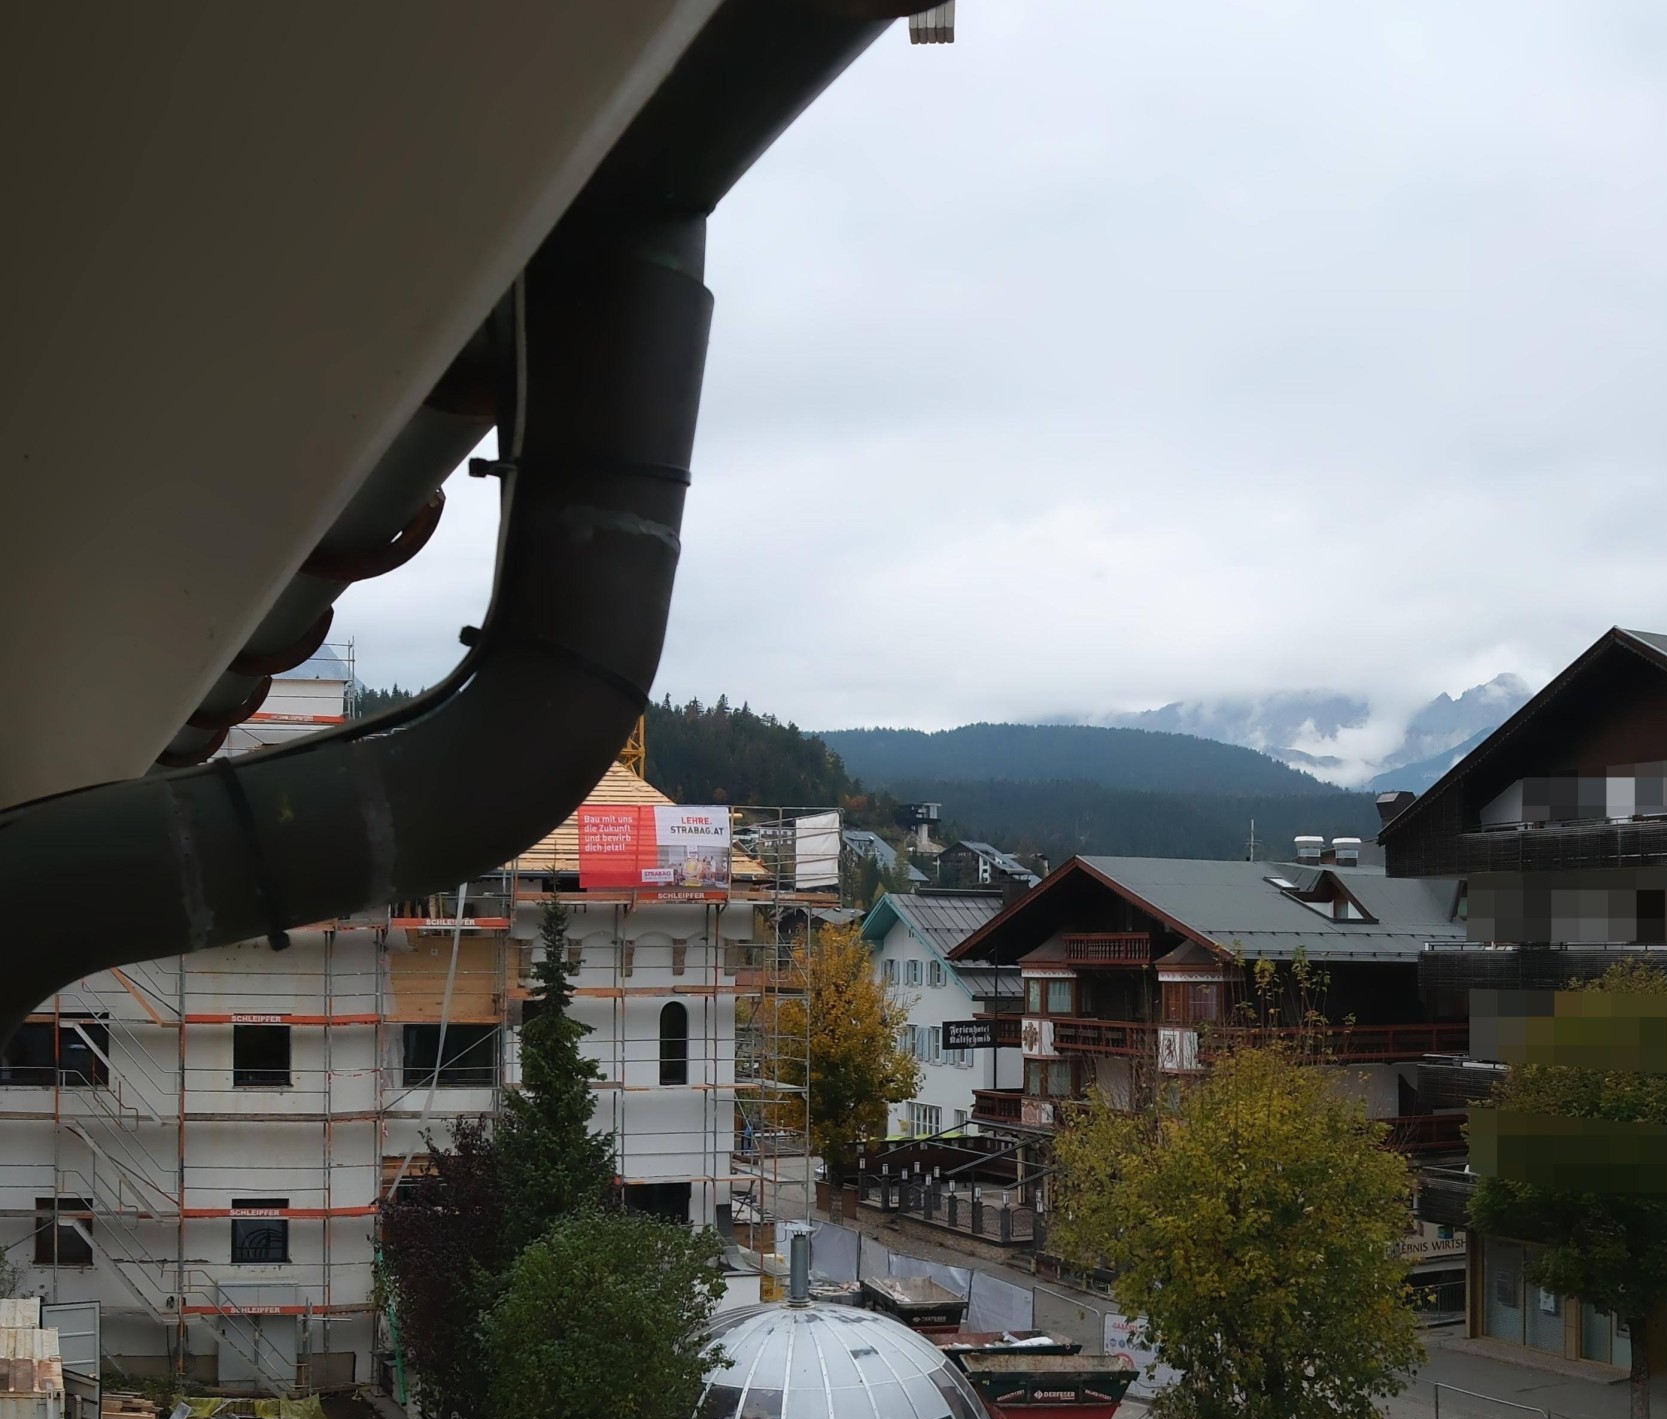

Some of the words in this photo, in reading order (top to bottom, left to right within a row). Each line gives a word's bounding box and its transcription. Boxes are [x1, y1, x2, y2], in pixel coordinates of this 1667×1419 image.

[584, 815, 600, 823] Bau
[602, 815, 616, 823] mit
[681, 816, 712, 825] LEHRE.
[599, 825, 631, 833] Zukunft
[670, 826, 724, 835] STRABAG.AT
[585, 834, 600, 842] und
[602, 834, 631, 842] bewirb
[585, 843, 601, 851] dich
[603, 844, 625, 853] jetzt!
